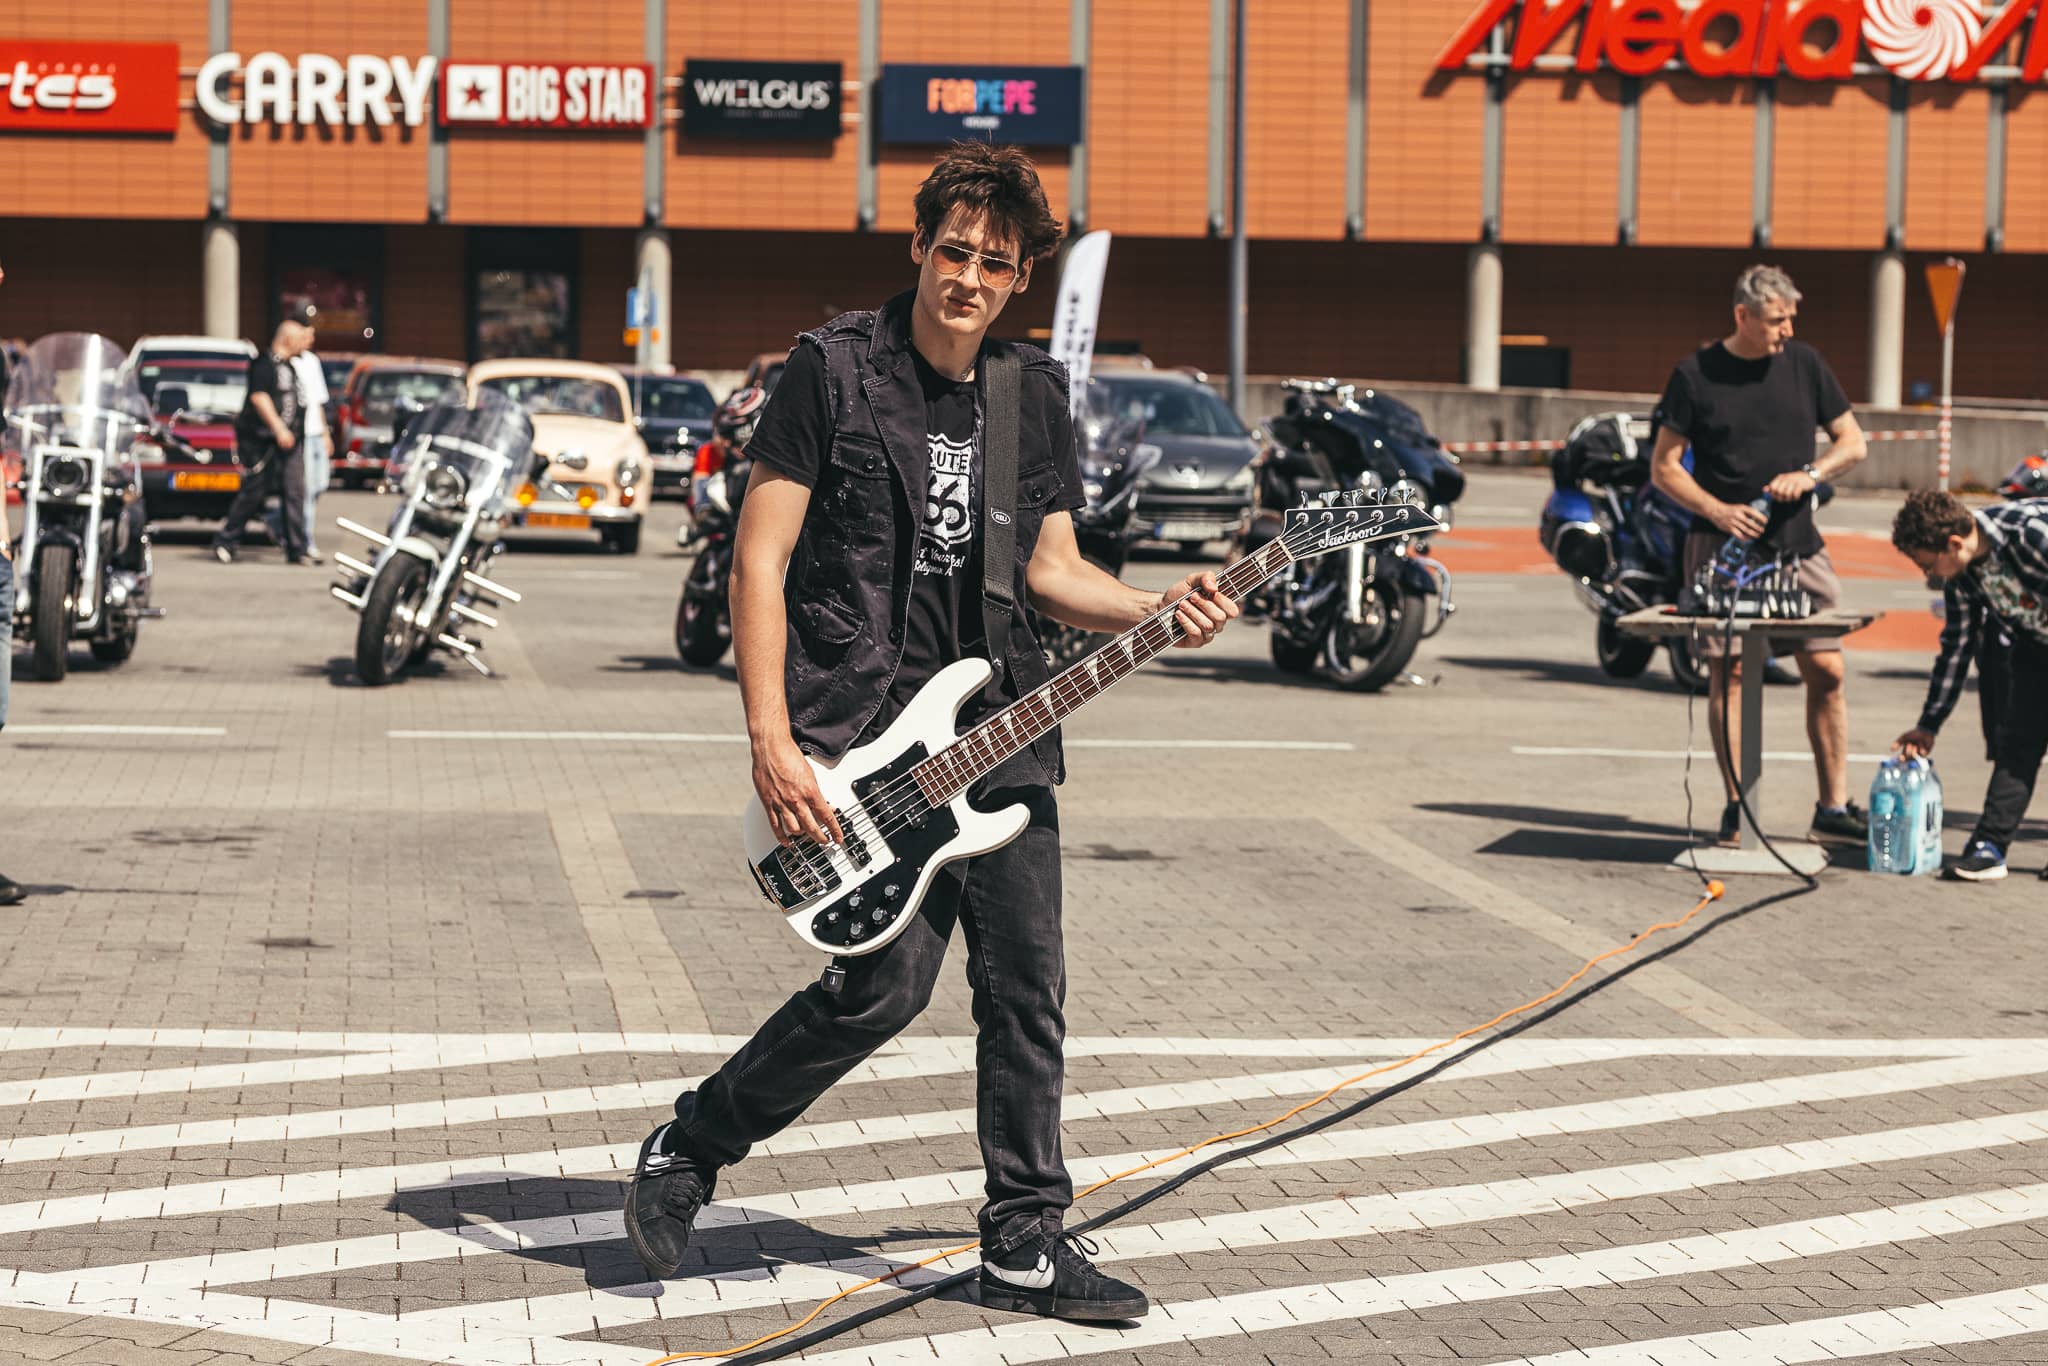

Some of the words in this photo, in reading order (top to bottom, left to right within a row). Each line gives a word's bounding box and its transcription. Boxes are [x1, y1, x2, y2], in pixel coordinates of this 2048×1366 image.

[196, 52, 437, 126] CARRY
[505, 65, 561, 122] BIG
[564, 67, 648, 123] STAR
[1318, 526, 1383, 549] Jackson
